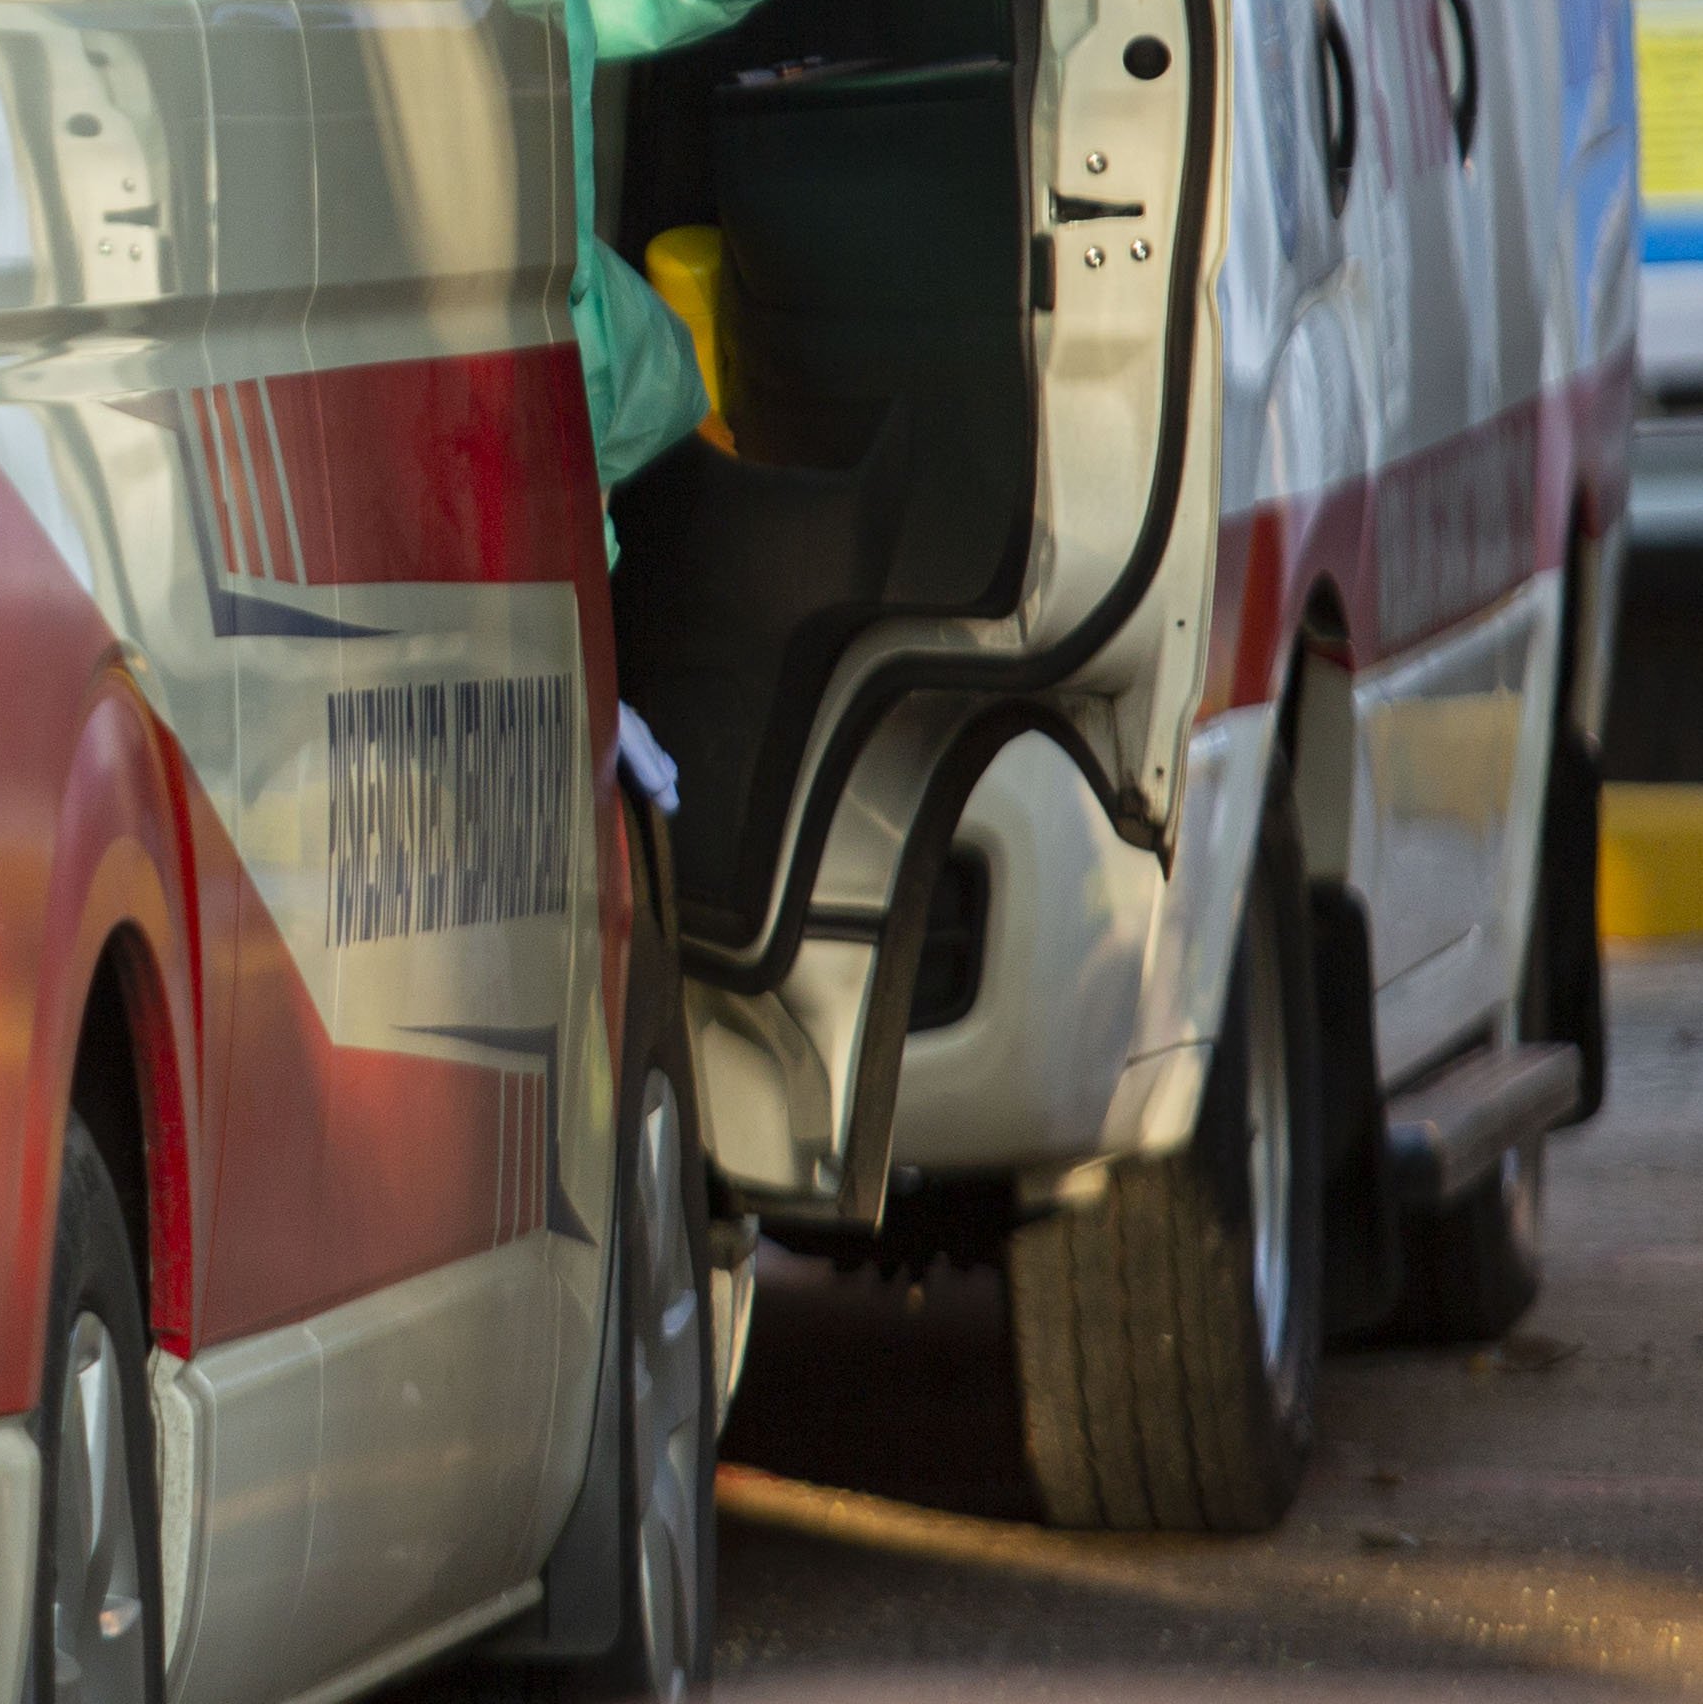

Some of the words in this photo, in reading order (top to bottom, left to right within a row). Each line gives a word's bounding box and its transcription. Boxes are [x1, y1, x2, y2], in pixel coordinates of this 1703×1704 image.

[326, 682, 416, 948] PUSKESMAS
[453, 674, 534, 926] KEBAYORAN
[534, 671, 573, 914] BARU
